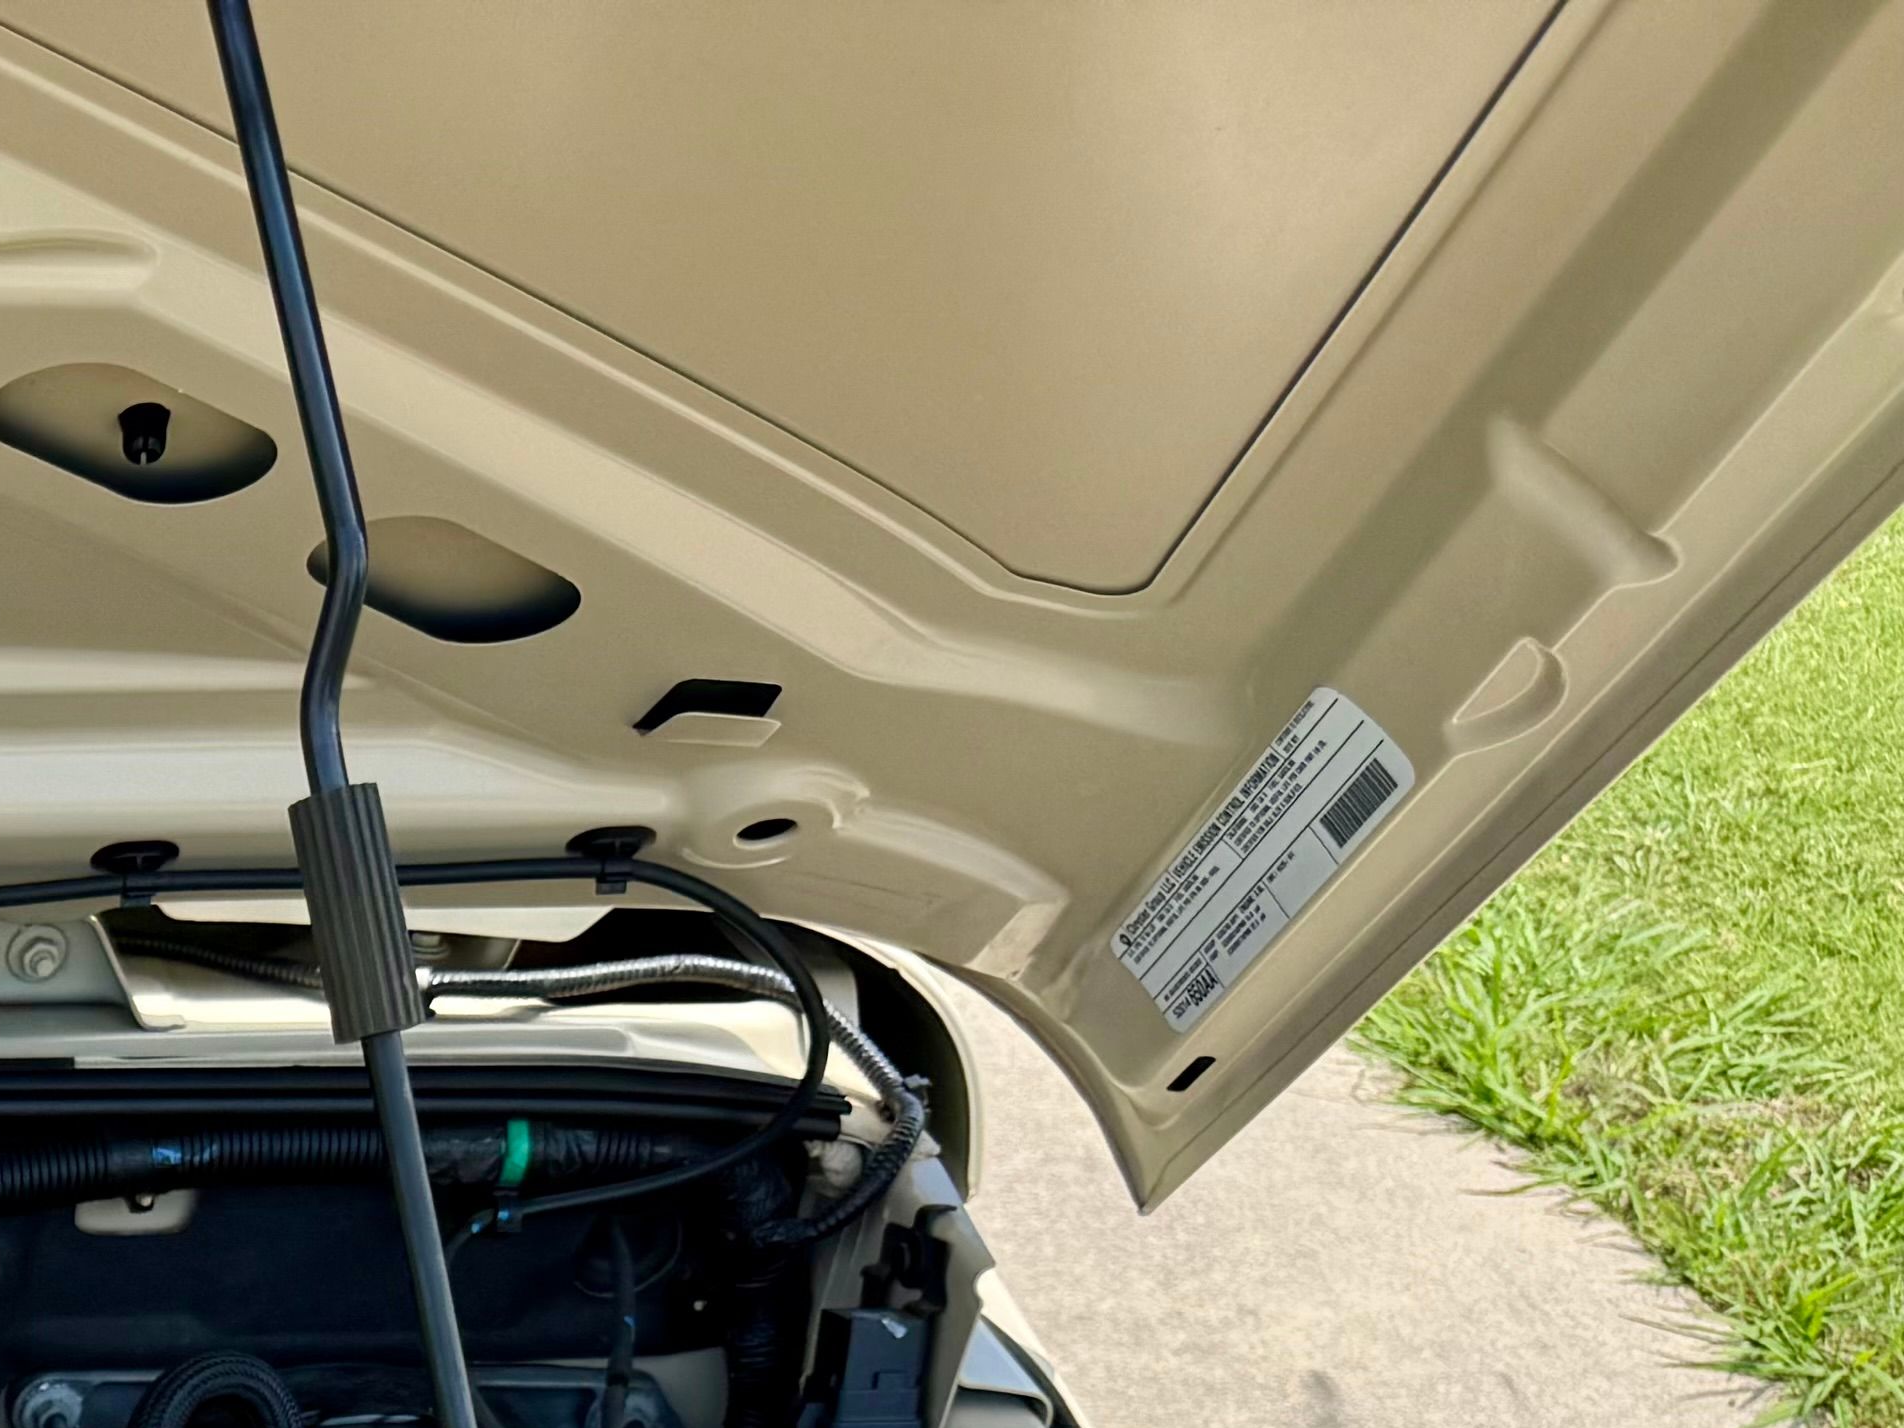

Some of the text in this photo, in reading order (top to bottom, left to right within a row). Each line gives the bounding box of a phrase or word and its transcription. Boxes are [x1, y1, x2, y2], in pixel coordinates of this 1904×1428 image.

[1173, 752, 1281, 881] VEHICLE EMISSION CONTROL INFORMATION
[1145, 888, 1168, 915] Group
[1160, 877, 1176, 894] LLC
